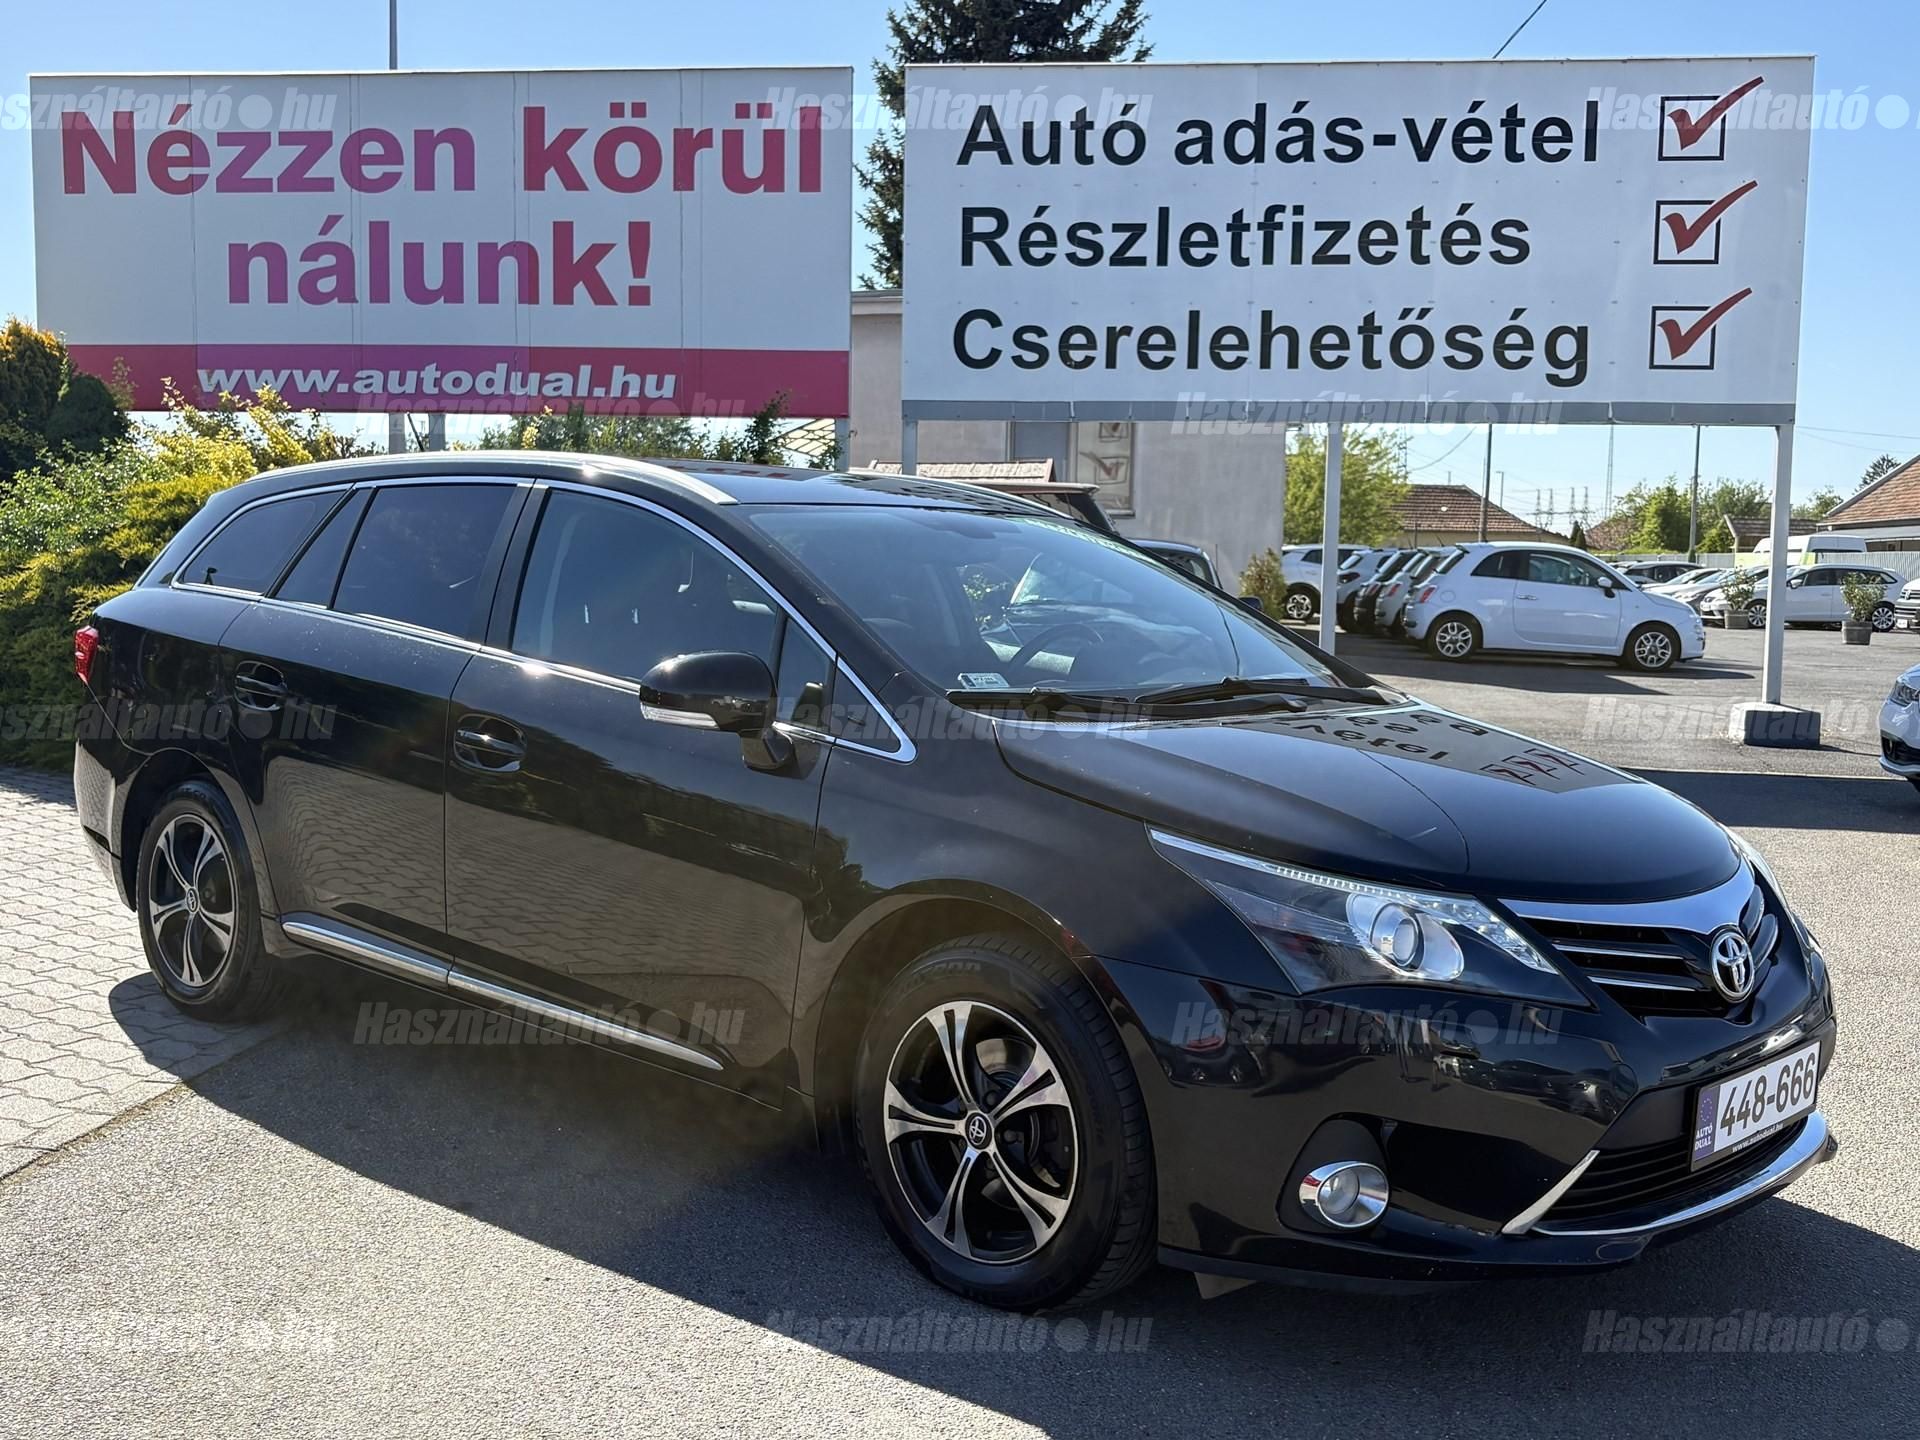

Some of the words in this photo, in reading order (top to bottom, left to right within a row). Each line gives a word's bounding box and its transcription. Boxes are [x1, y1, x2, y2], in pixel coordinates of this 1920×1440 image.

[63, 104, 475, 195] Nézzen
[525, 102, 822, 194] körül
[956, 103, 1148, 167] Autó
[1174, 99, 1600, 167] adás-vétel
[230, 216, 651, 306] nálunk!
[961, 202, 1531, 269] Részletfizetés
[197, 362, 677, 404] www.autodual.hu
[953, 307, 1590, 389] Cserelehetőség
[1720, 1052, 1816, 1137] 448-666
[1694, 1136, 1712, 1150] DUAL
